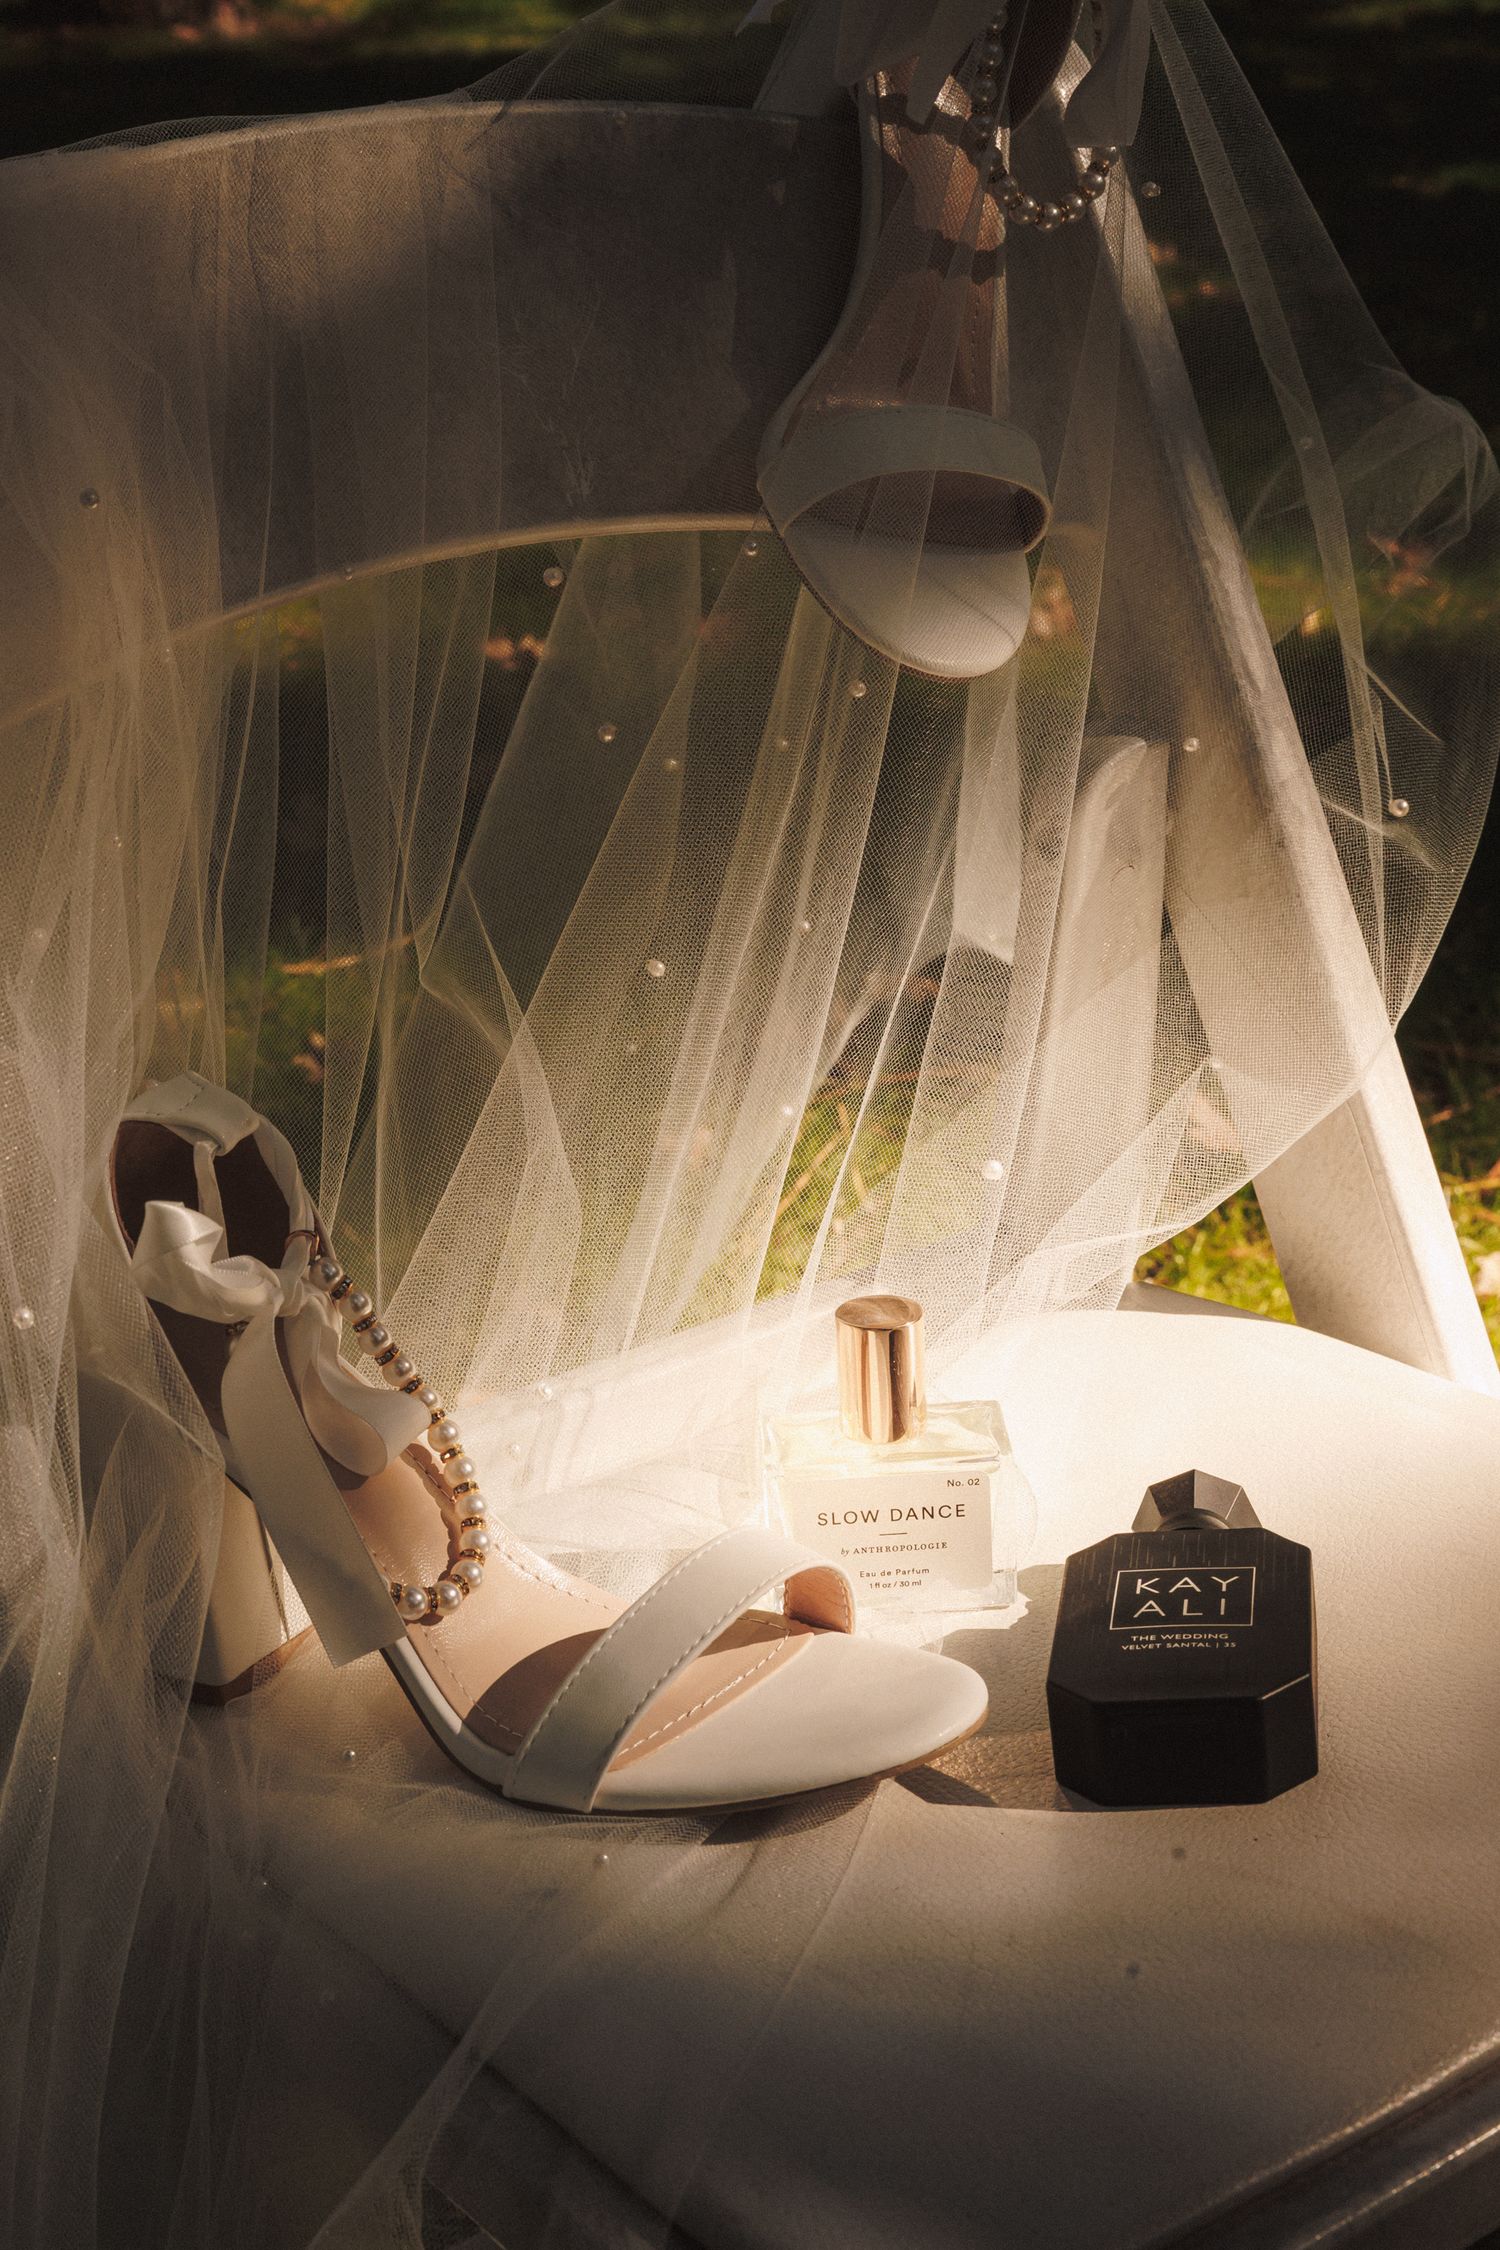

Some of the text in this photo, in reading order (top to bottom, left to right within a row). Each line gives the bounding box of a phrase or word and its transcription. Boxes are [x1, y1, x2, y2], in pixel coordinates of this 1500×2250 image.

[946, 1478, 980, 1487] No. 02
[817, 1503, 966, 1526] SLOW DANCE
[840, 1541, 948, 1556] by ANTHROPOLOGIE
[859, 1567, 930, 1578] Eau de Parfum
[911, 1579, 922, 1587] ml
[1135, 1575, 1240, 1595] KAY
[1132, 1598, 1226, 1618] ALI
[1121, 1642, 1162, 1651] VELVET
[1166, 1641, 1212, 1649] SANTAL
